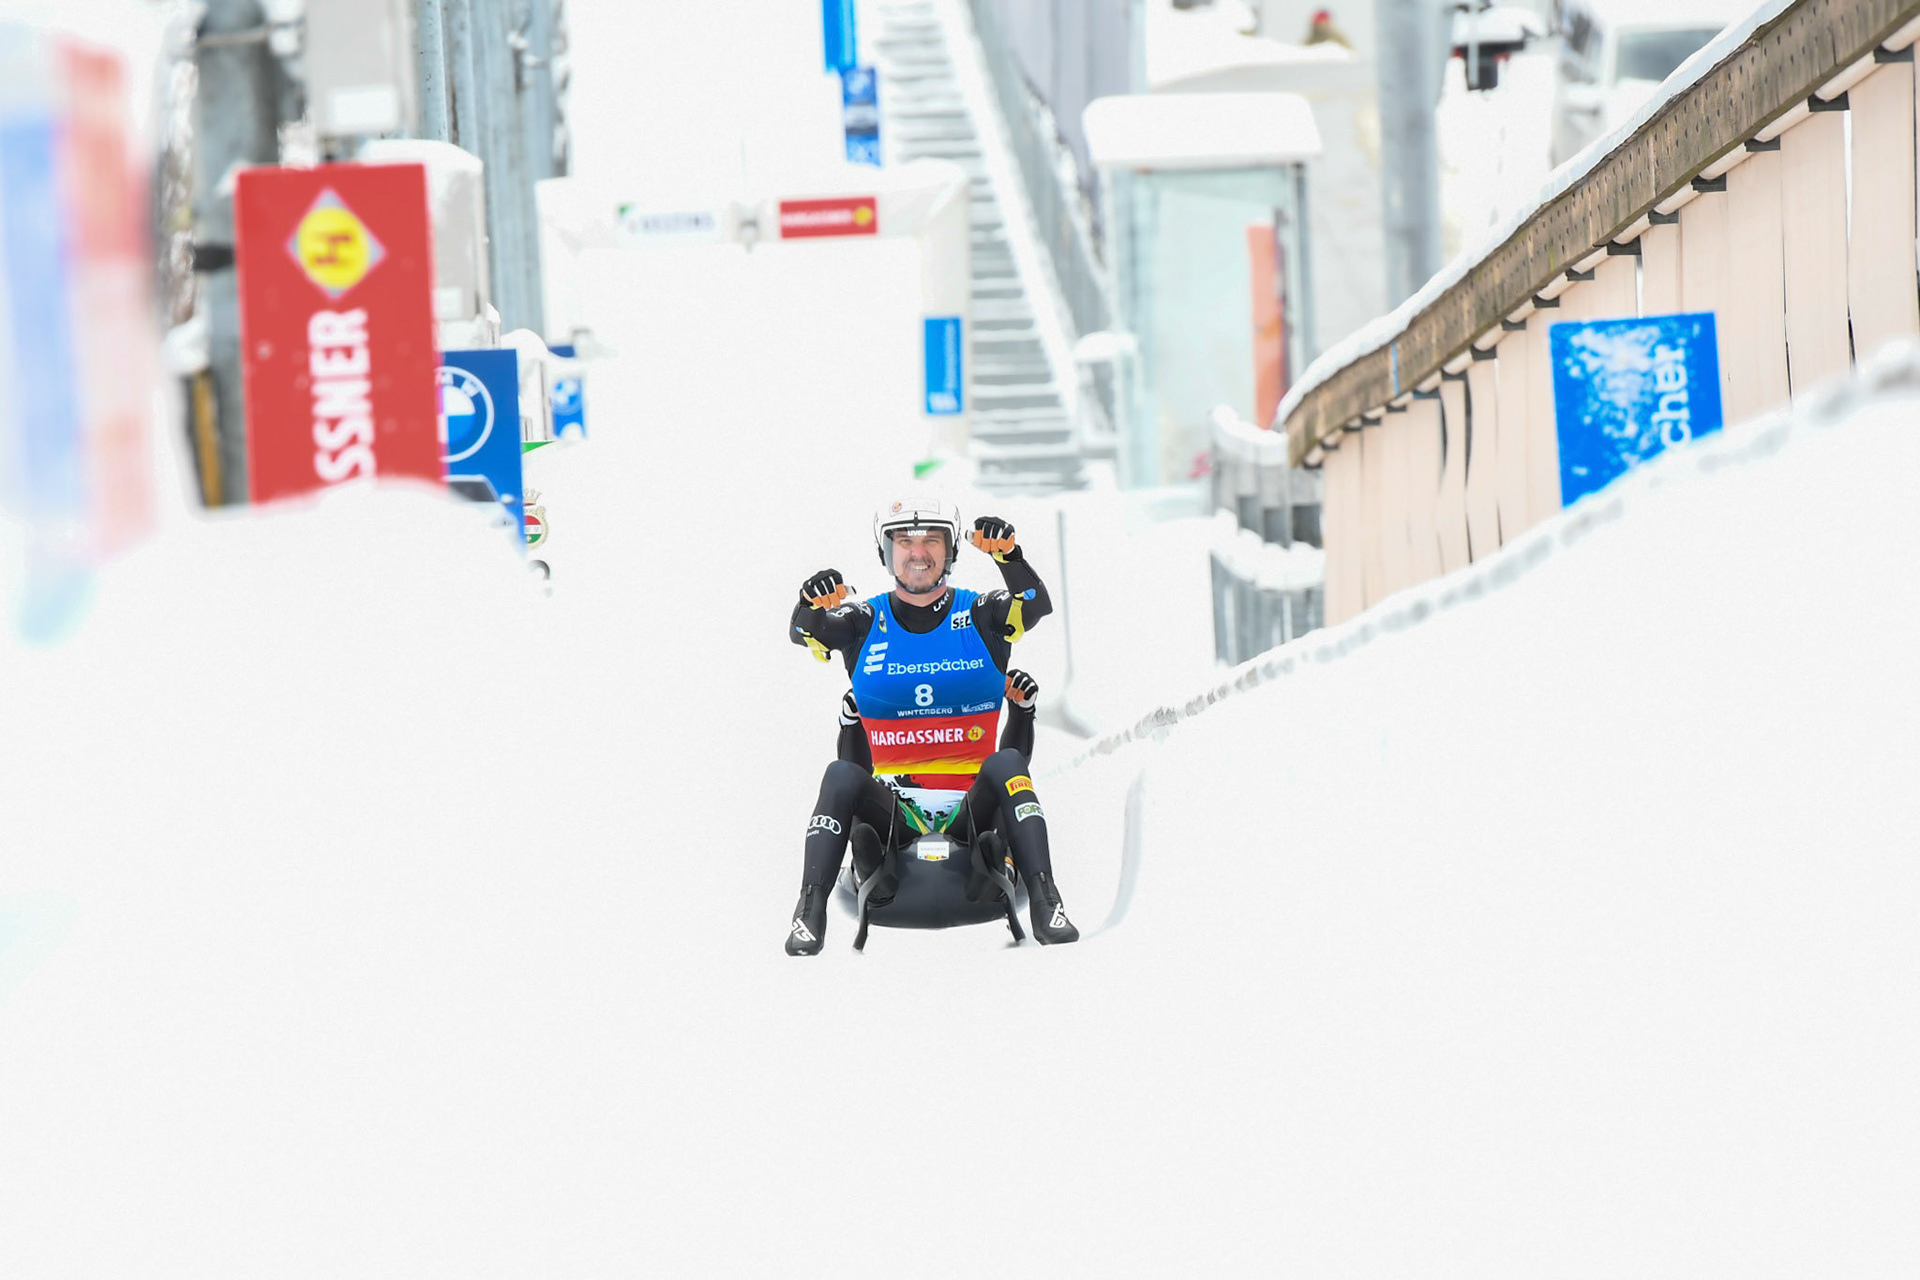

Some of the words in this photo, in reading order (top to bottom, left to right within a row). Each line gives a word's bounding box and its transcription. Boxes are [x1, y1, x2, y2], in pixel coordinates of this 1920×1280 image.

[887, 658, 985, 675] Eberspächer
[914, 683, 934, 707] 8
[897, 707, 953, 717] WINTERBERG
[870, 728, 964, 746] HARGASSNER
